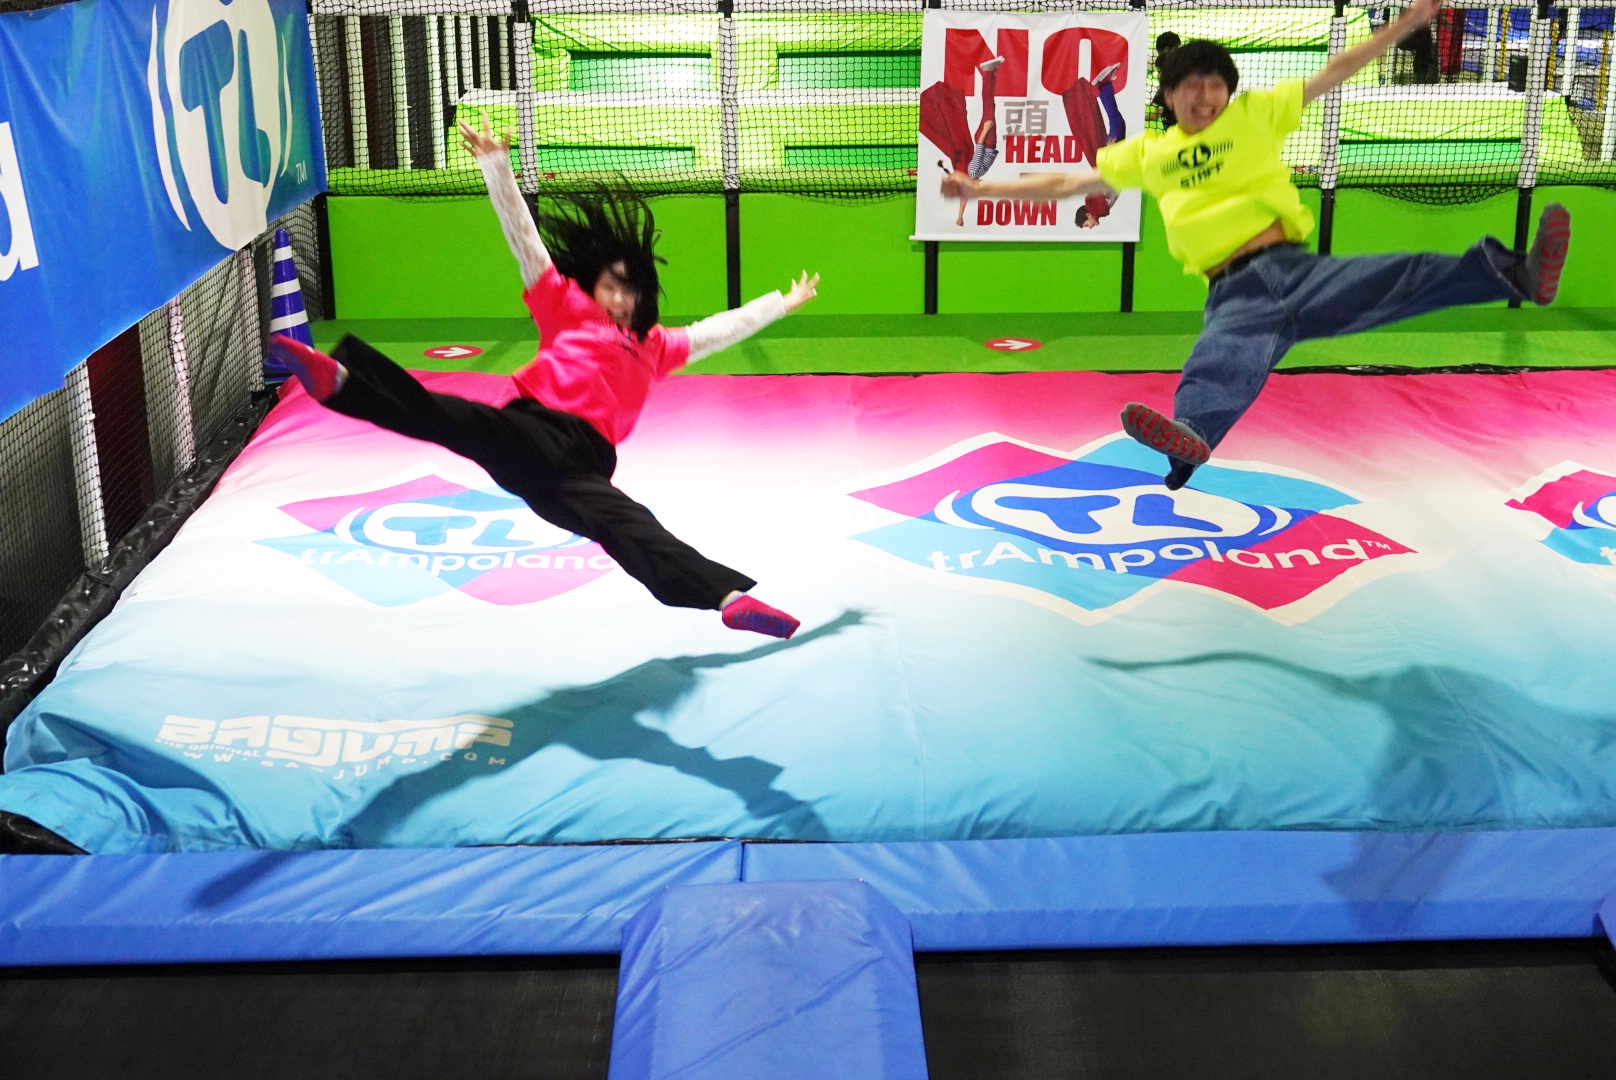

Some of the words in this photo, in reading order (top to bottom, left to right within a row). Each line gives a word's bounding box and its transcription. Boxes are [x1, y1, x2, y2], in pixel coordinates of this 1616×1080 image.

[944, 27, 1129, 97] NO
[1003, 100, 1049, 141] 頭
[1005, 135, 1083, 164] HEAD
[977, 199, 1058, 226] DOWN
